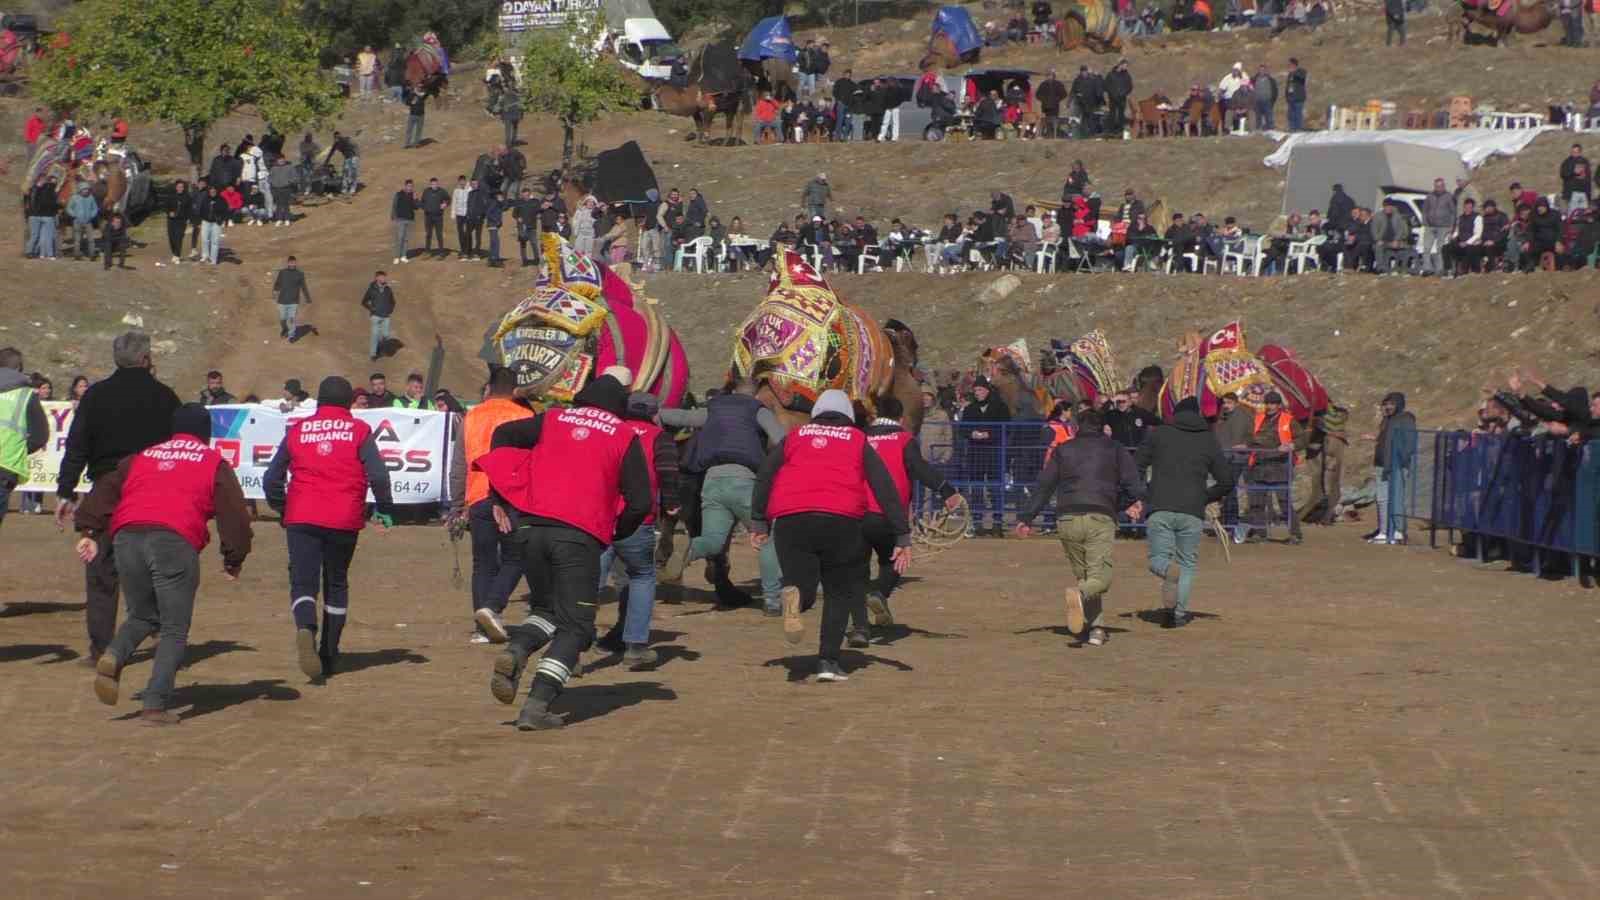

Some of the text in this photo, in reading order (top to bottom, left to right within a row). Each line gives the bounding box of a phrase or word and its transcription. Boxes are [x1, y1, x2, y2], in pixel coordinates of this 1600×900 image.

[514, 0, 551, 13] DAYAN
[557, 413, 616, 436] URGANCI
[300, 431, 354, 444] URGANCI
[799, 426, 851, 441] URGANCI
[143, 449, 204, 463] URGANCI
[393, 481, 410, 493] 64
[414, 482, 430, 494] 47
